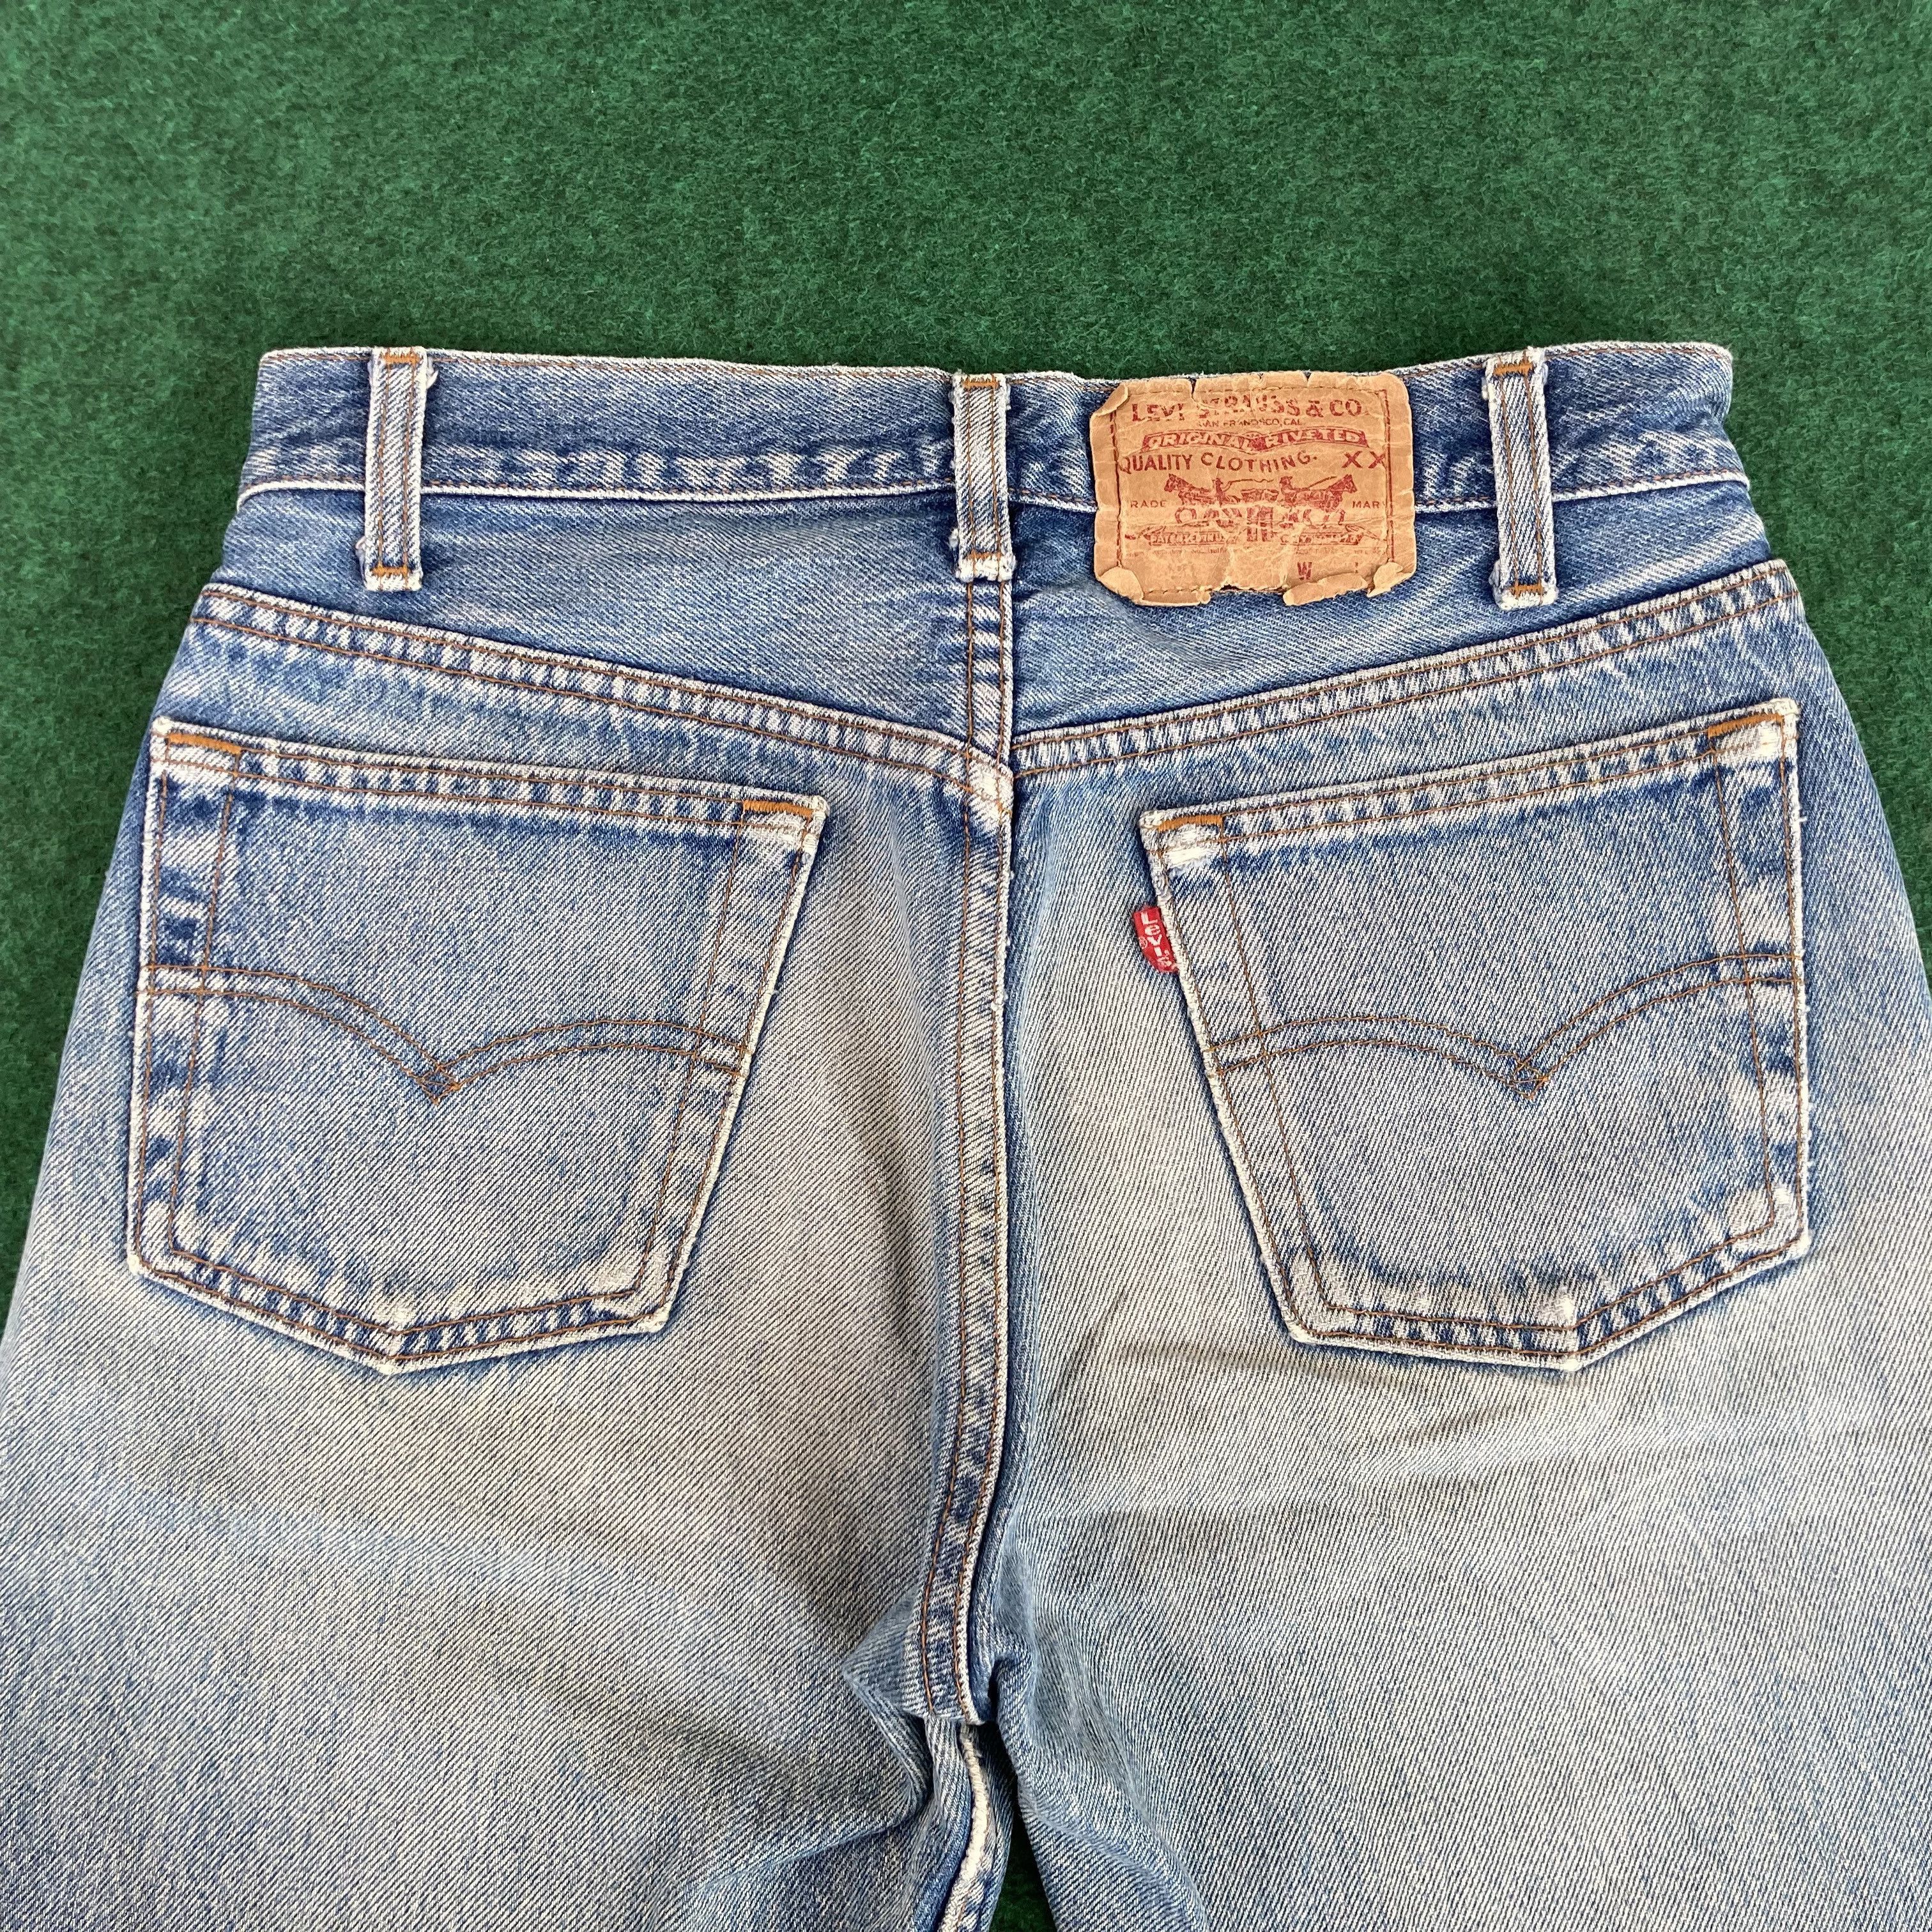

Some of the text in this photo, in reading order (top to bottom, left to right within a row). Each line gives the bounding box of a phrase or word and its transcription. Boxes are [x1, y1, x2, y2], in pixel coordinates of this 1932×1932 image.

[1131, 402, 1185, 422] LEVI
[1305, 399, 1324, 417] &
[1148, 428, 1361, 451] ORIGINAL RIVETED
[1118, 454, 1193, 475] QUALITY
[1297, 562, 1312, 580] W
